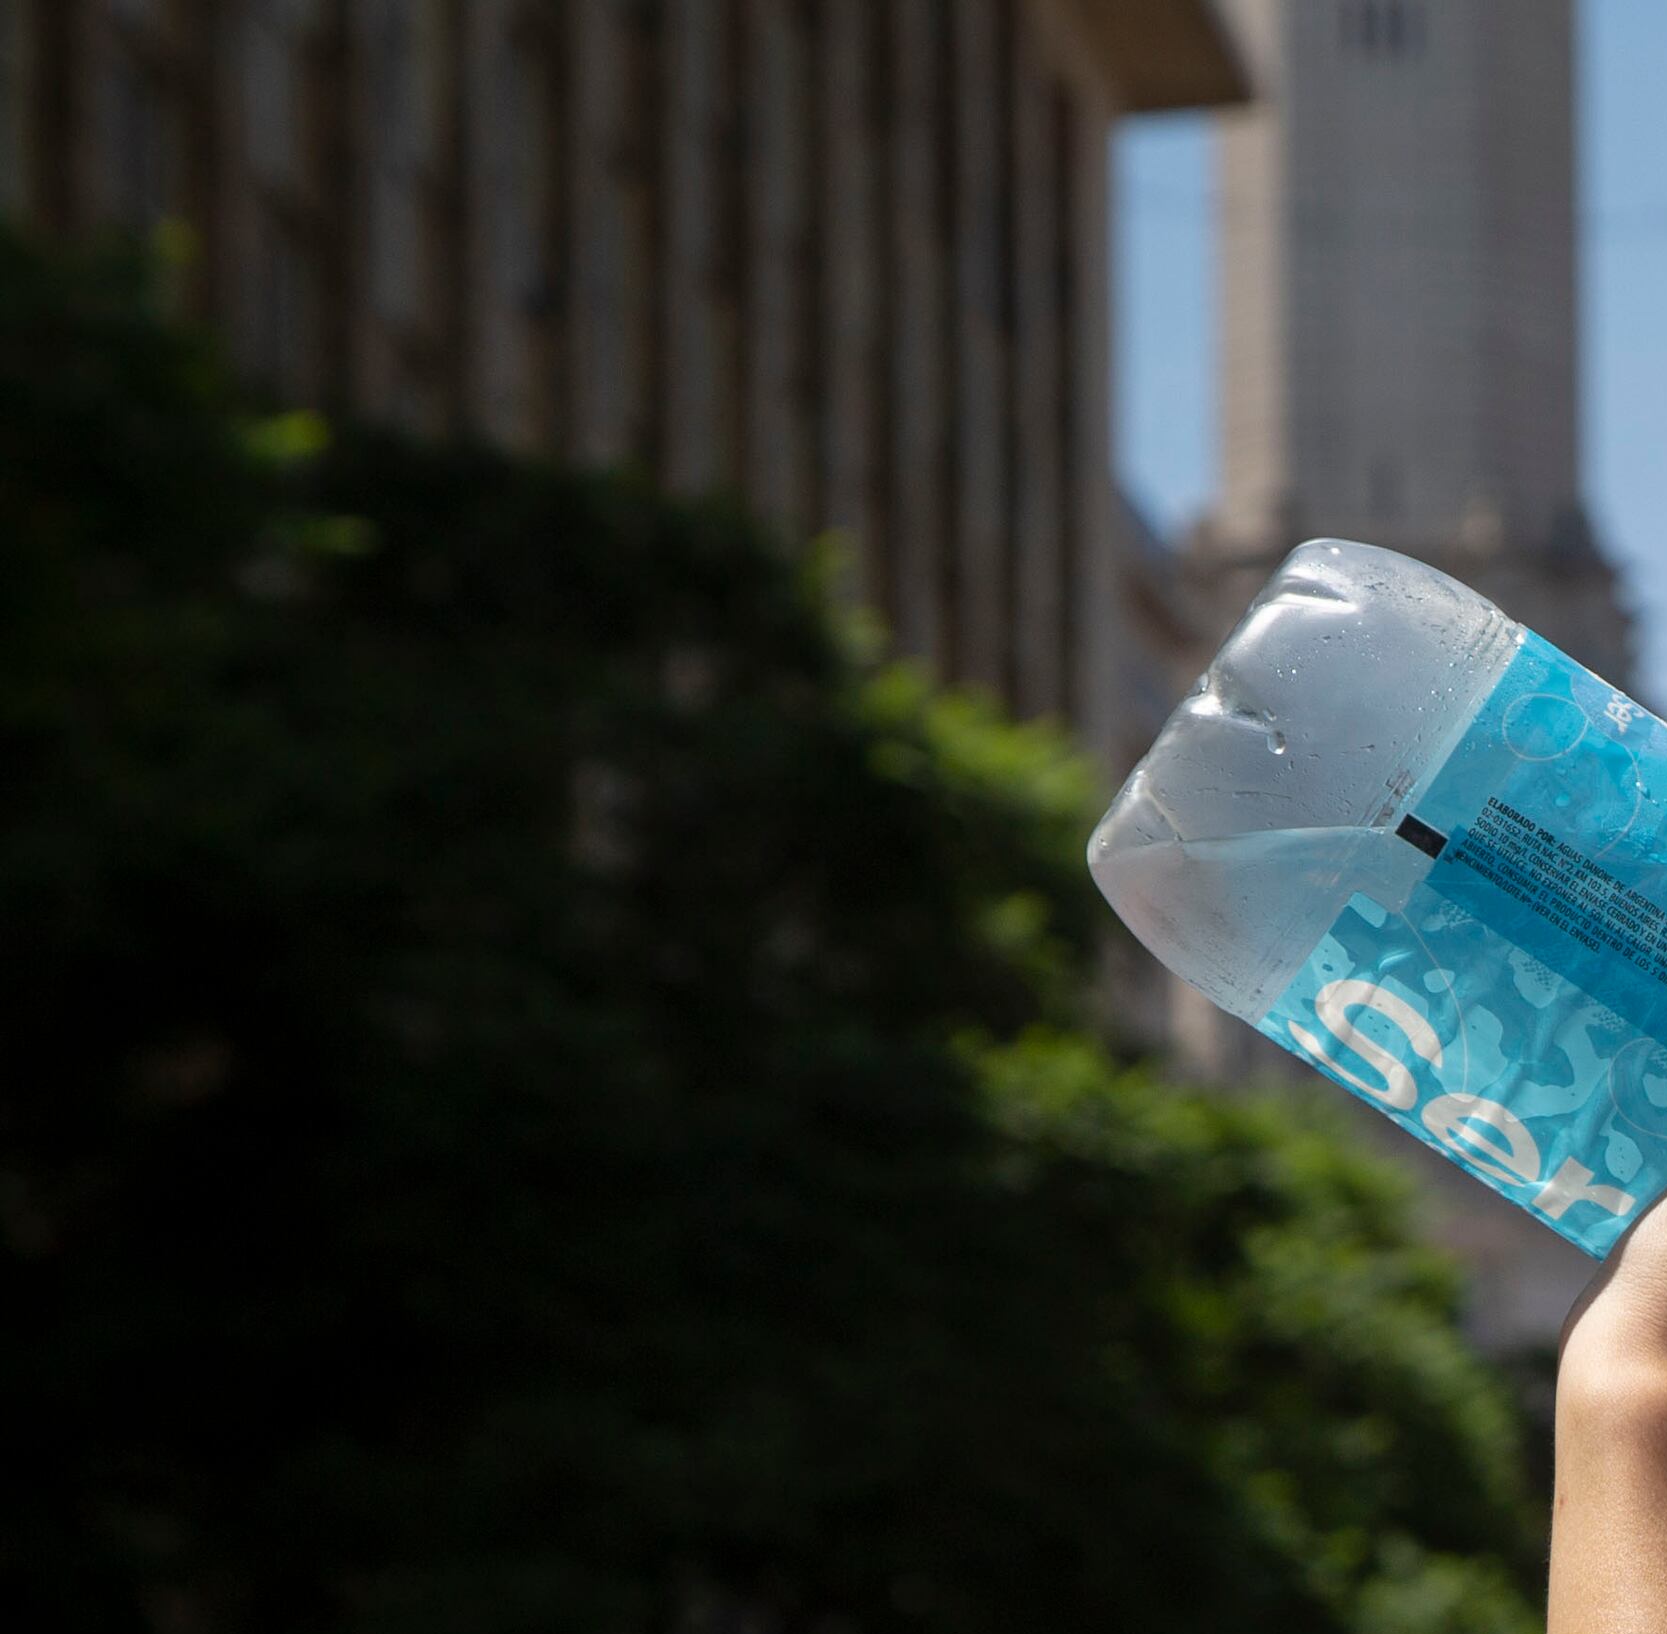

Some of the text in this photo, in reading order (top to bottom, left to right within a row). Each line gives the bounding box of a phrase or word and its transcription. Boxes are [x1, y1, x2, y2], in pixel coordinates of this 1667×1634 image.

[1467, 826, 1487, 845] QUE
[1484, 838, 1497, 851] SE
[1527, 867, 1543, 882] NO
[1540, 876, 1578, 906] EXPONER
[1575, 900, 1589, 914] AL
[1587, 908, 1605, 925] SOL
[1603, 919, 1615, 932] NI
[1613, 925, 1627, 940] AL
[1473, 815, 1499, 837] SODIO
[1496, 831, 1510, 844] 10
[1527, 852, 1571, 886] CONSERVAR
[1567, 879, 1581, 893] EL
[1577, 886, 1608, 911] ENVASE
[1604, 905, 1641, 933] CERRADO
[1637, 927, 1646, 937] Y
[1643, 931, 1658, 945] EN
[1487, 795, 1536, 833] ELABORADO
[1534, 827, 1557, 847] POR:
[1555, 841, 1583, 864] AGUAS
[1581, 859, 1615, 886] DANONE
[1612, 879, 1626, 894] DE
[1624, 888, 1667, 921] ARGENTINA
[1521, 833, 1543, 852] RUTA
[1539, 846, 1560, 863] NAC.
[1573, 868, 1588, 883] KM
[1608, 892, 1639, 917] BUENOS
[1495, 861, 1539, 895] CONSUMIR
[1537, 889, 1550, 902] EL
[1548, 896, 1592, 931] PRODUCTO
[1590, 925, 1624, 952] DENTRO
[1621, 946, 1636, 961] DE
[1633, 955, 1652, 971] LOS
[1649, 966, 1659, 976] 5
[1531, 900, 1552, 919] (VER
[1548, 912, 1562, 926] EN
[1558, 919, 1571, 932] EL
[1288, 980, 1636, 1220] Ser
